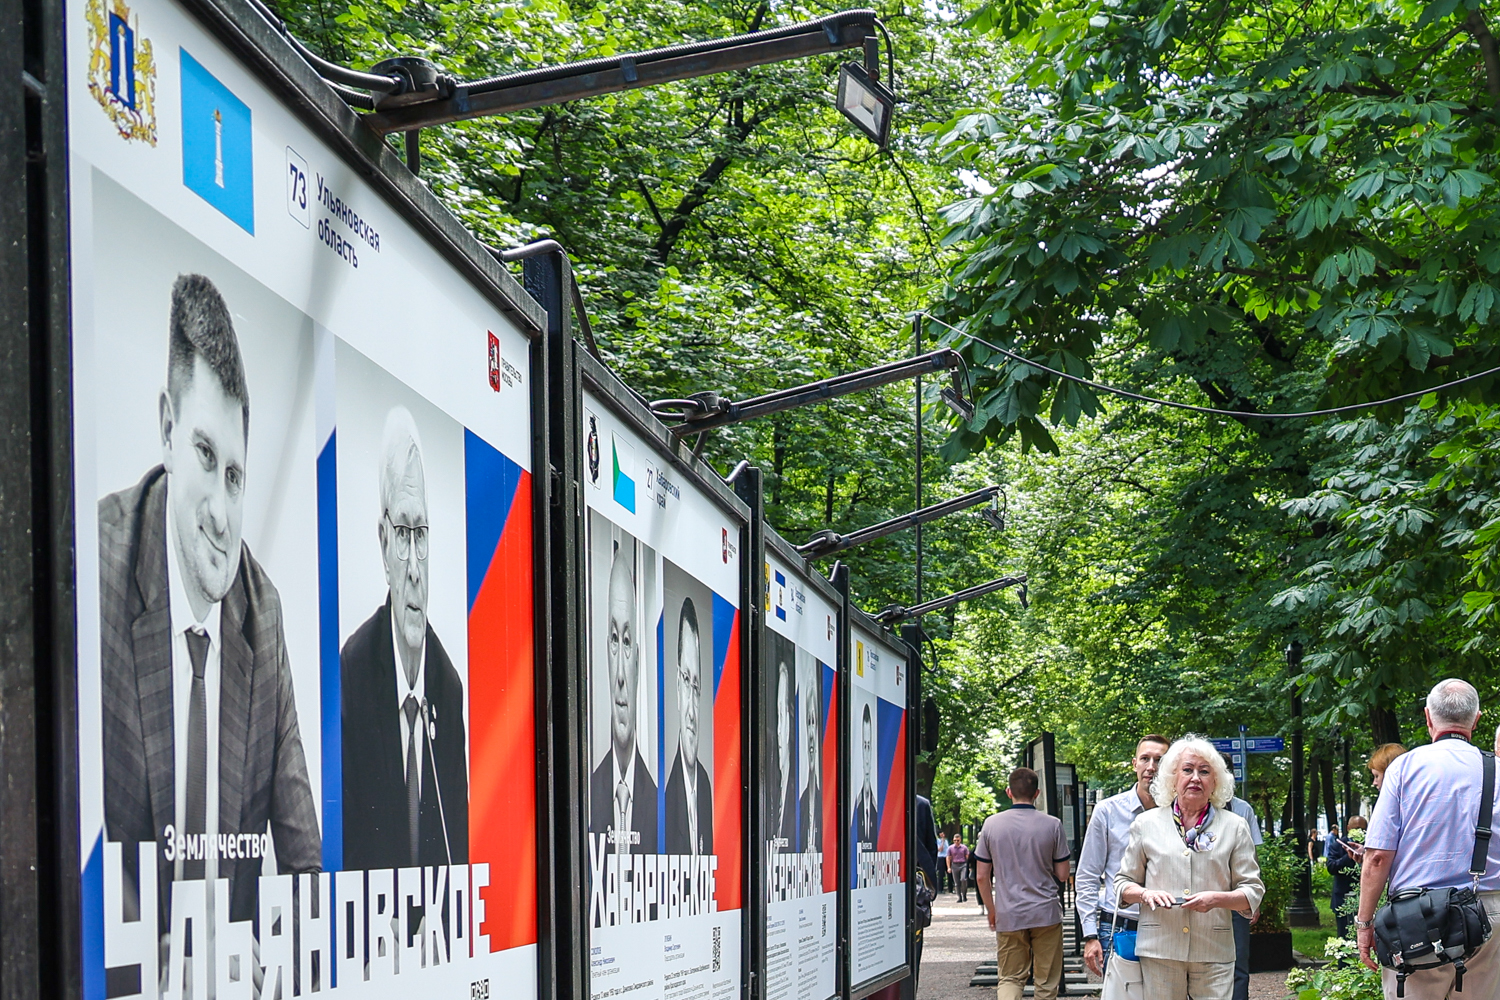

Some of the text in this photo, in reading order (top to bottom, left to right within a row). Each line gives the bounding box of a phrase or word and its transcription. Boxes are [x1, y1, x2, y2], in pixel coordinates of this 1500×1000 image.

[289, 162, 381, 253] 73 Ульяновская
[318, 218, 359, 269] область
[647, 467, 653, 490] 27
[164, 824, 269, 862] Землячество
[589, 832, 717, 929] ХАБАРОВСКОЕ
